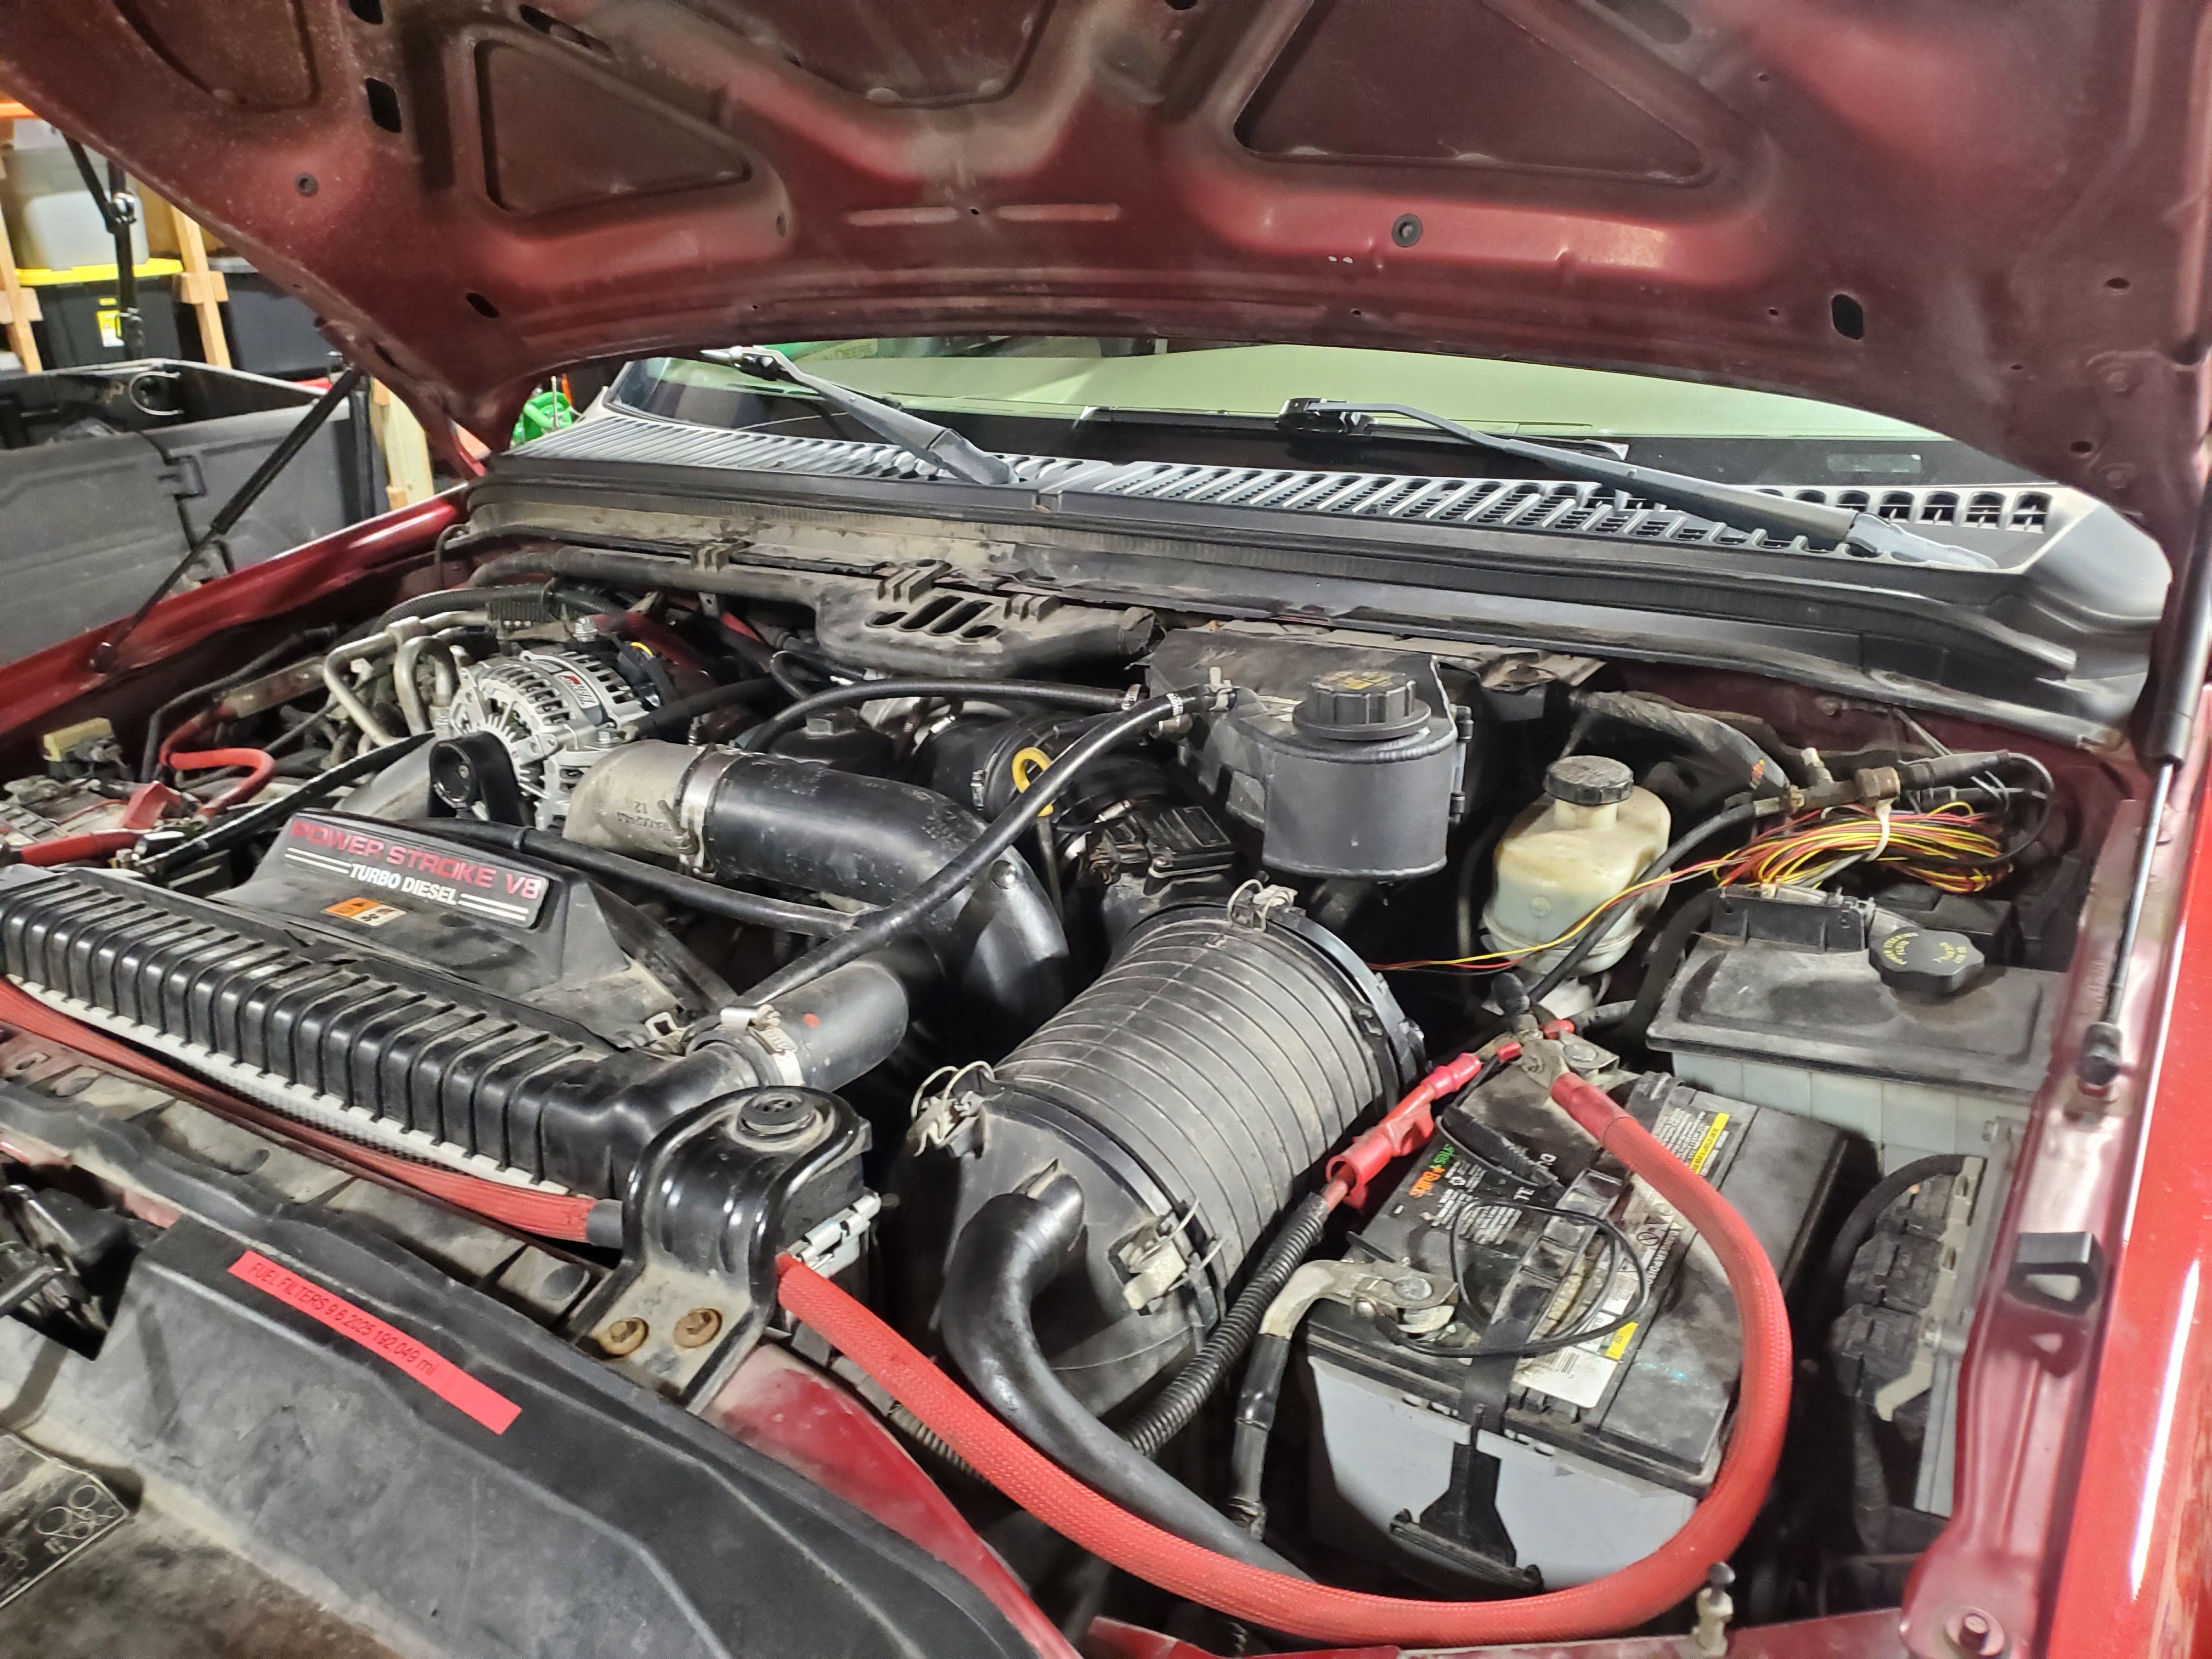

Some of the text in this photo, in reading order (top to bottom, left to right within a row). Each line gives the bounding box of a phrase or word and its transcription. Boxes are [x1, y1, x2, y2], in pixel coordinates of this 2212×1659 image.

[290, 821, 541, 900] POWER STROKE V8
[349, 863, 459, 906] TURBO DIESEL
[249, 1262, 275, 1284] FUEL
[278, 1277, 329, 1311] FILTERS
[328, 1304, 375, 1336] 9.6.2025
[416, 1359, 439, 1375] mi
